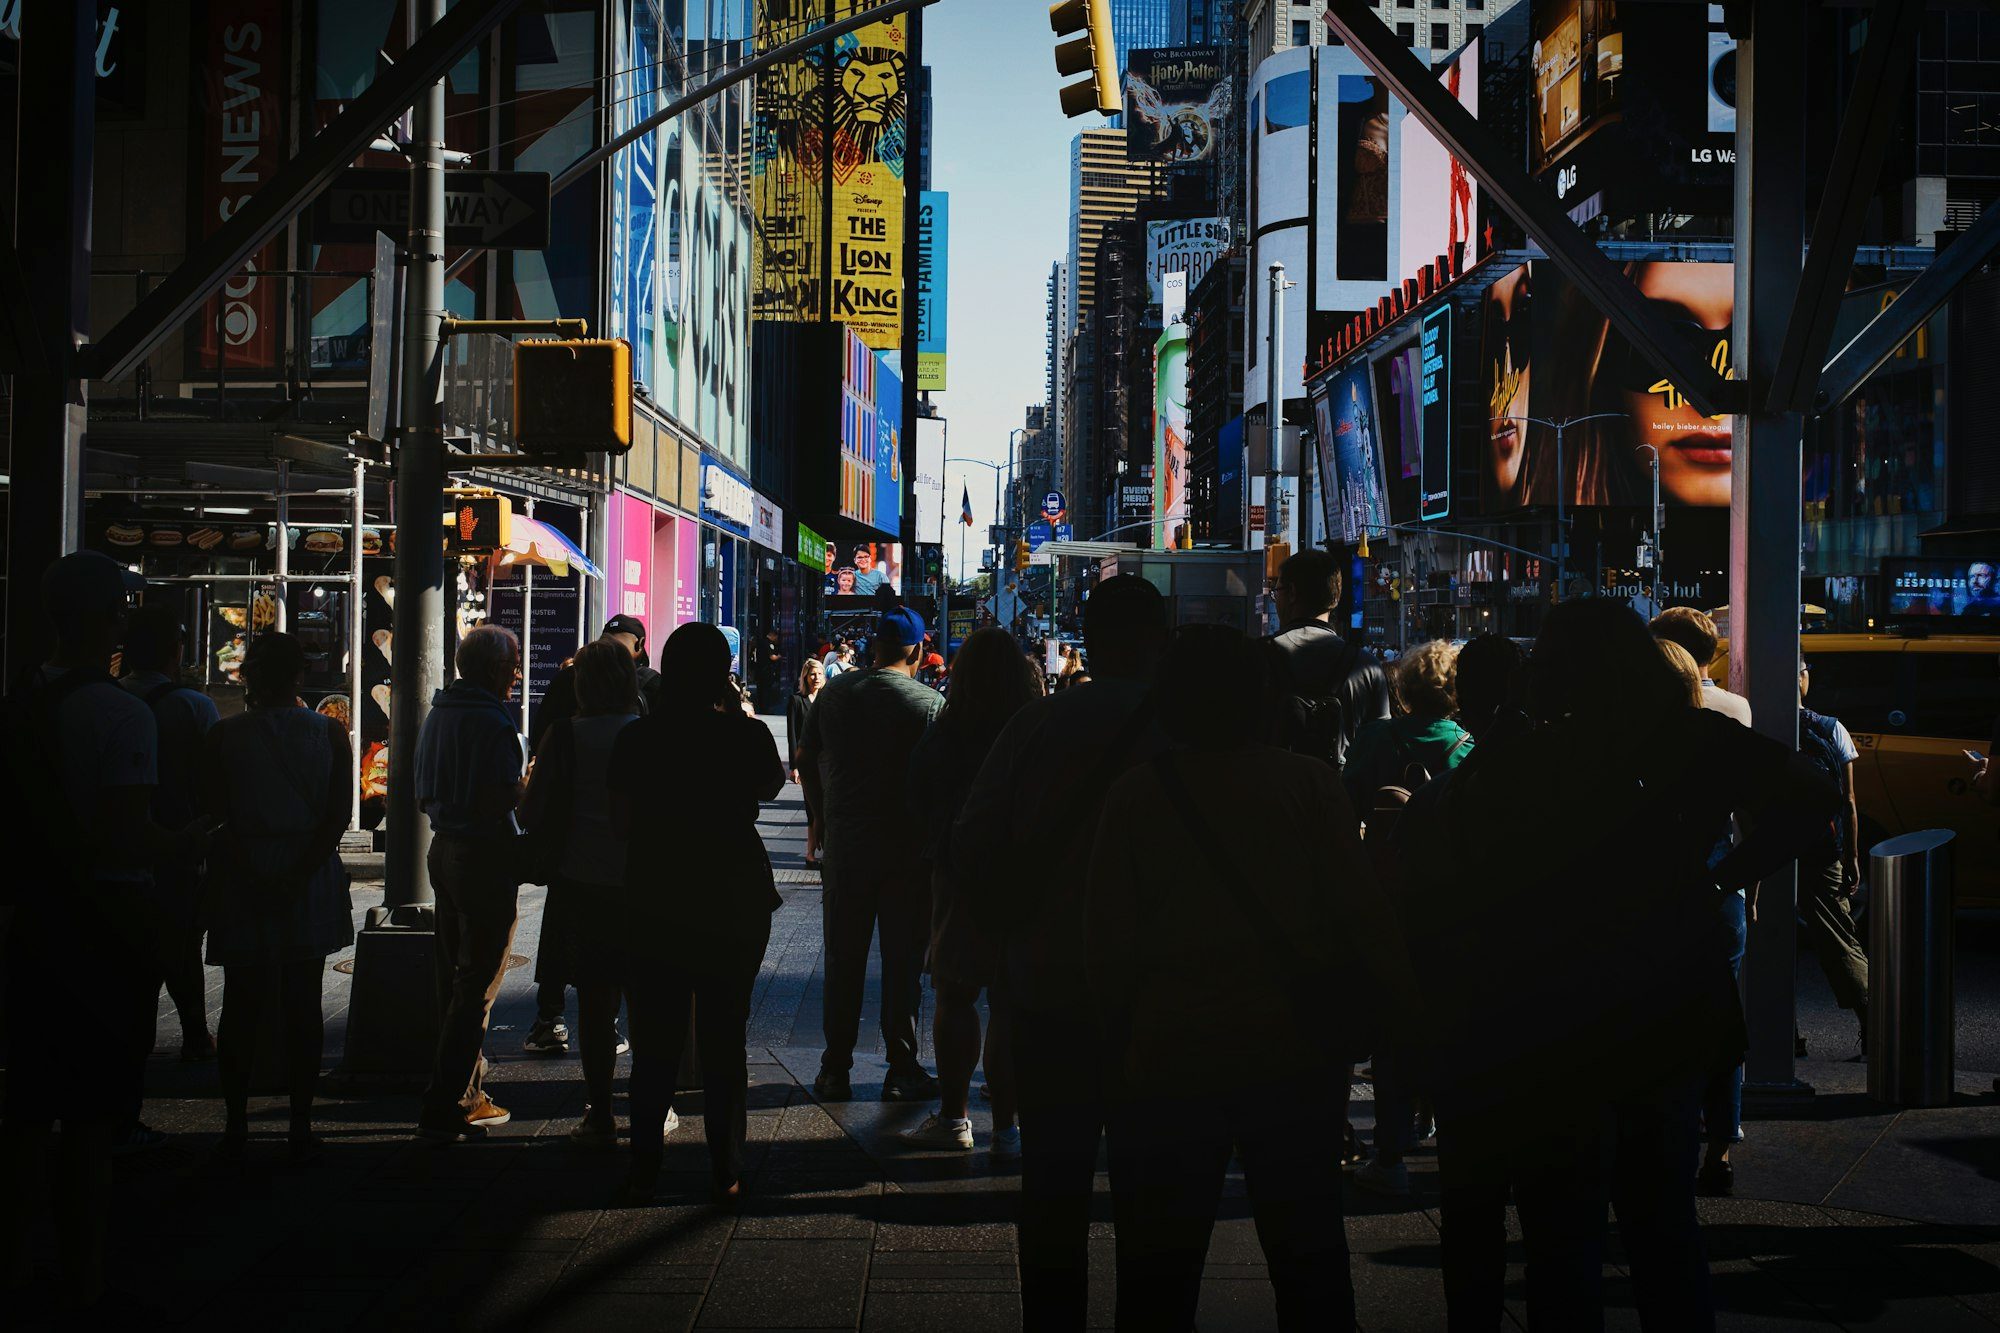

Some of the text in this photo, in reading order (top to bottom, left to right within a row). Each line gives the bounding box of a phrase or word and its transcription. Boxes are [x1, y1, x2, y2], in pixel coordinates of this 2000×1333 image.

[1152, 50, 1215, 59] ON BROADWAY
[1150, 63, 1184, 87] Harry
[220, 21, 263, 183] NEWS
[1691, 148, 1736, 163] LG Wa
[1565, 165, 1577, 190] LG
[444, 195, 511, 224] WAY
[851, 192, 884, 209] Disney
[847, 215, 887, 236] THE
[1157, 222, 1202, 250] LITTLE
[918, 204, 933, 293] FAMILIES
[1190, 241, 1200, 249] OF
[840, 242, 893, 276] LION
[1156, 250, 1214, 284] HORRO
[1166, 279, 1183, 289] COS
[833, 278, 899, 316] KING
[1319, 242, 1464, 369] 1540 BROADWAY
[1652, 421, 1675, 431] hailey
[1676, 421, 1700, 430] bieber
[1709, 423, 1731, 431] vogue
[1123, 486, 1153, 494] EVERY
[1123, 494, 1149, 503] HERO
[1600, 580, 1702, 599] sungls hut
[1895, 577, 1967, 588] RESPONDER
